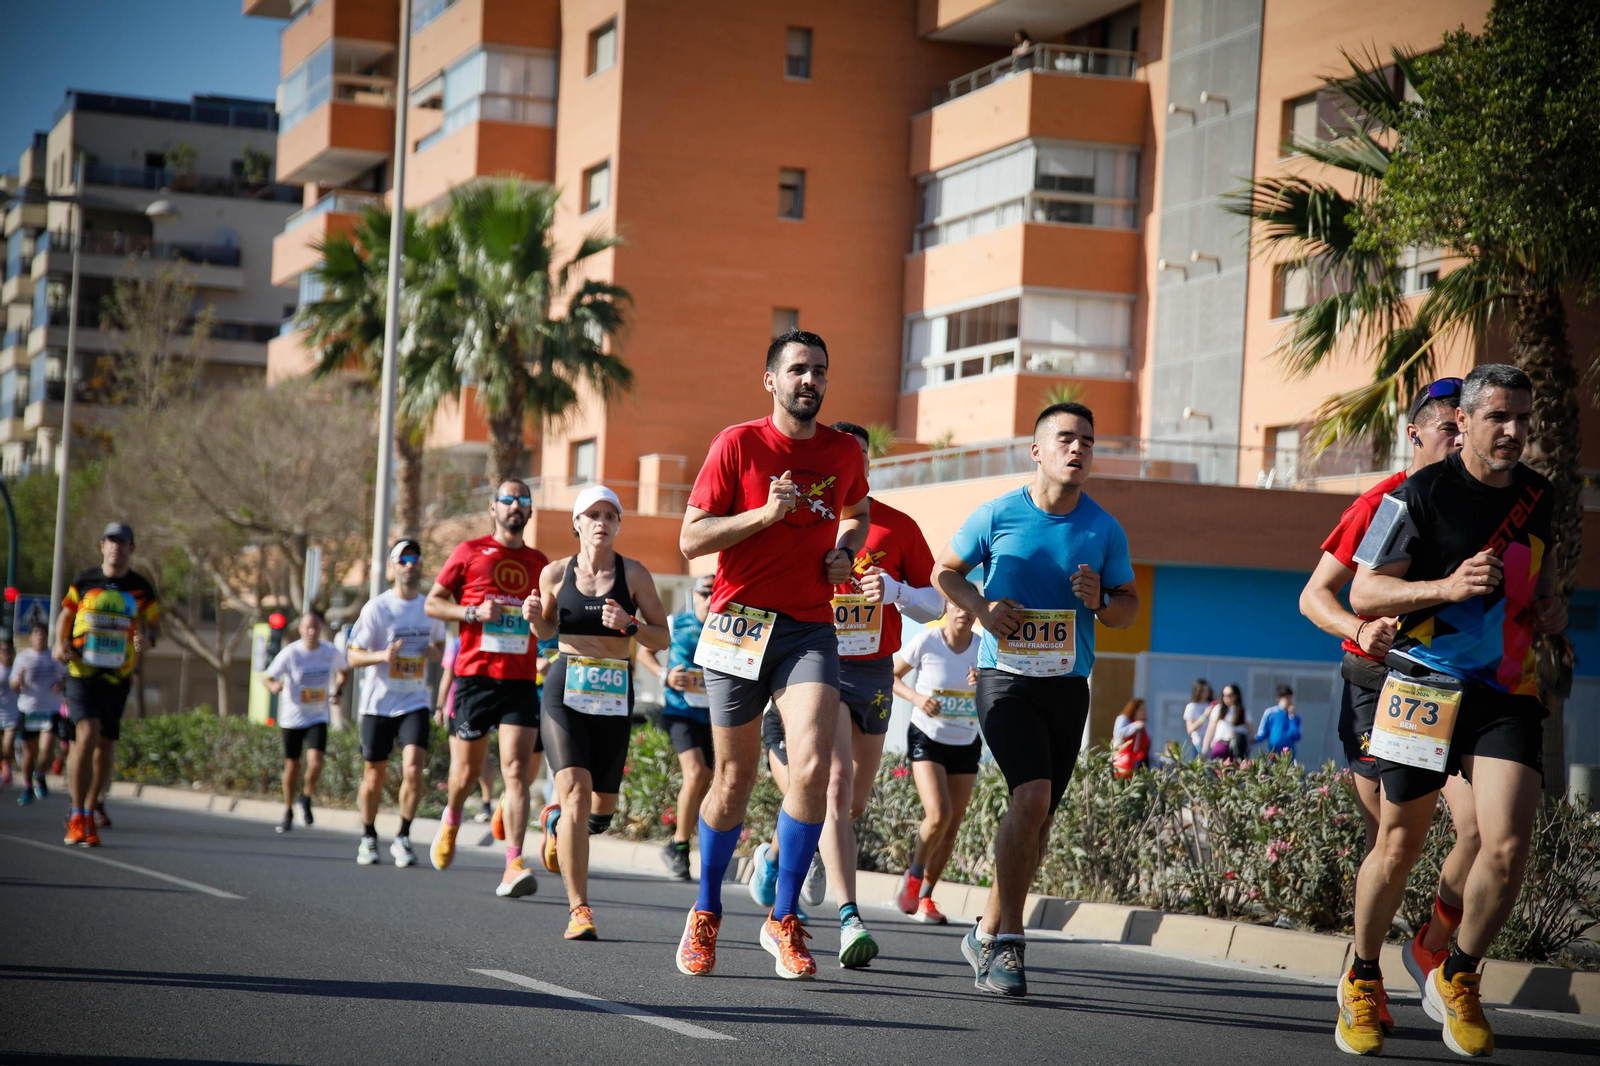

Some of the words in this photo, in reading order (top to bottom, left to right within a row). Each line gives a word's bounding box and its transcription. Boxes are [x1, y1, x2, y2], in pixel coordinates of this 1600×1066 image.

[833, 605, 876, 623] 017
[708, 612, 764, 642] 2004
[1007, 621, 1068, 642] 2016
[716, 633, 743, 645] ANTONIO
[574, 666, 623, 687] 1646
[936, 696, 976, 711] 2023
[1388, 695, 1440, 726] 873
[1400, 721, 1418, 730] BENI
